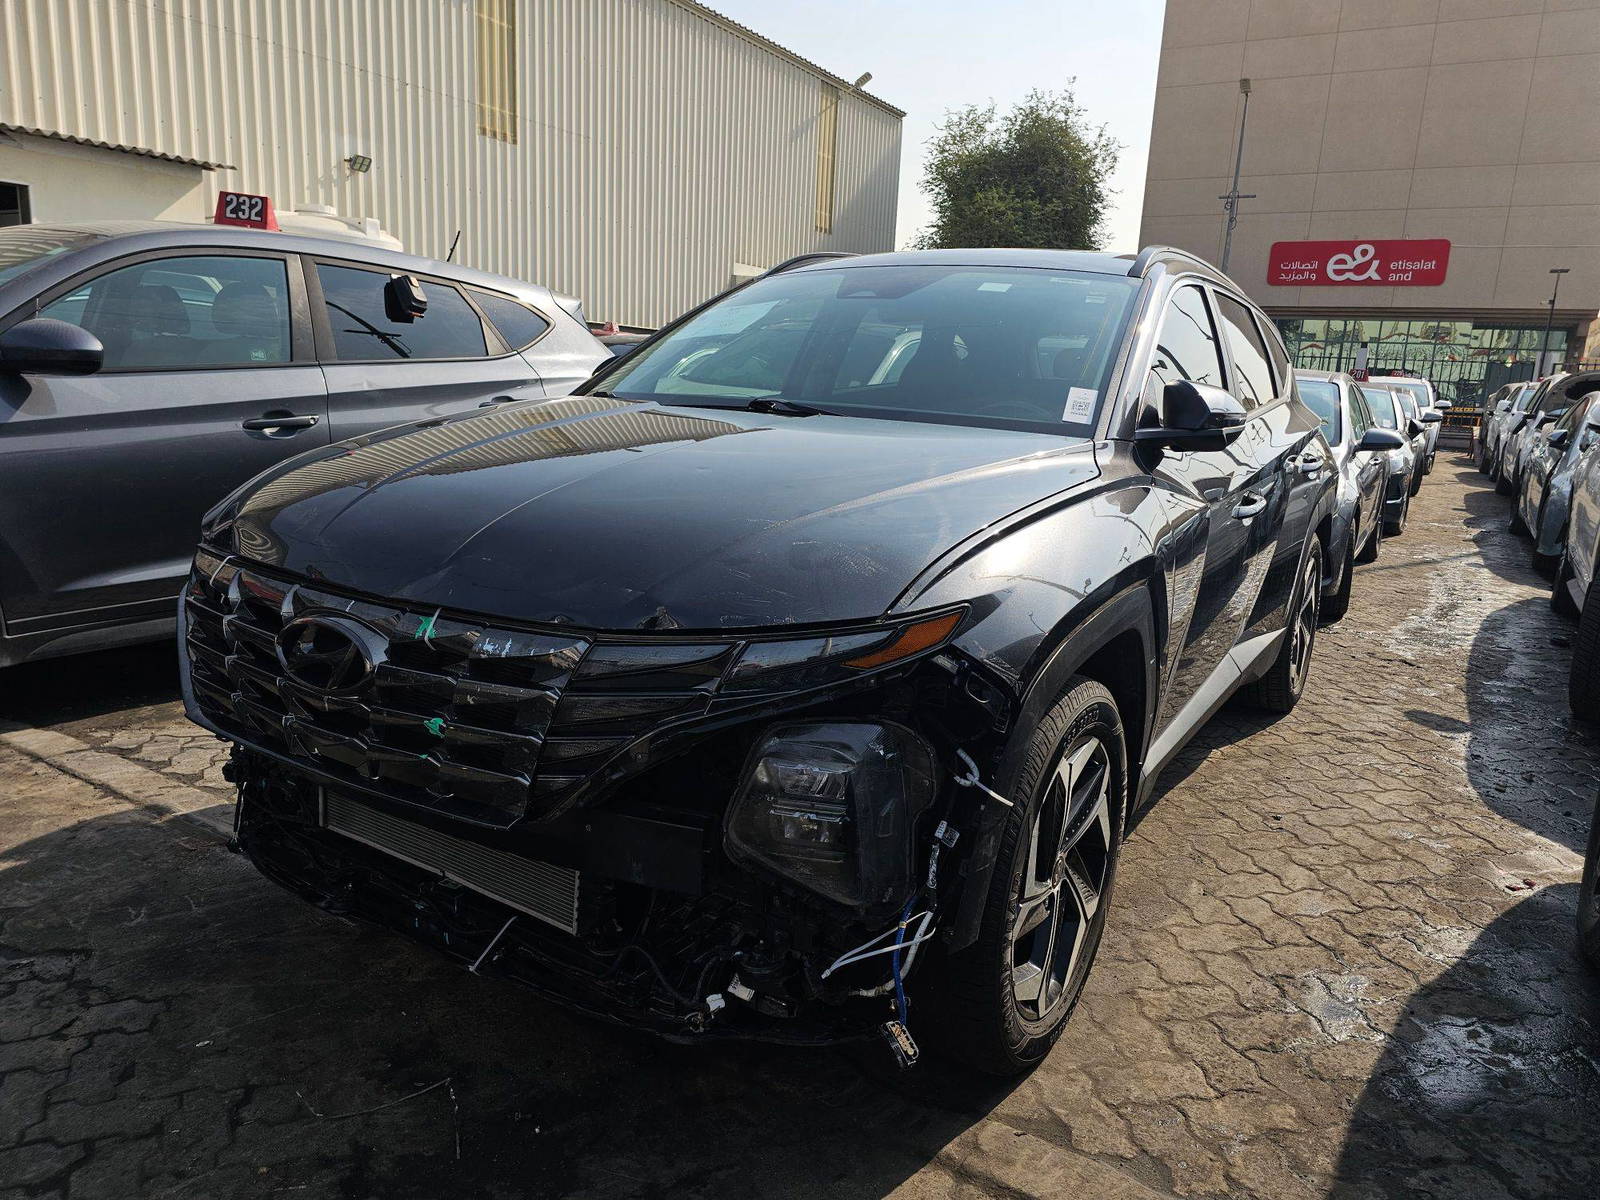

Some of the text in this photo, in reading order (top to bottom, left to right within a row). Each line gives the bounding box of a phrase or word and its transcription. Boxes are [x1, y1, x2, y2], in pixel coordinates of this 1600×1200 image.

[225, 194, 263, 222] 232
[1280, 260, 1318, 270] اتصالات
[1326, 243, 1382, 282] e&
[1390, 259, 1436, 270] etisalat
[1388, 271, 1412, 281] and
[1352, 370, 1365, 379] 201
